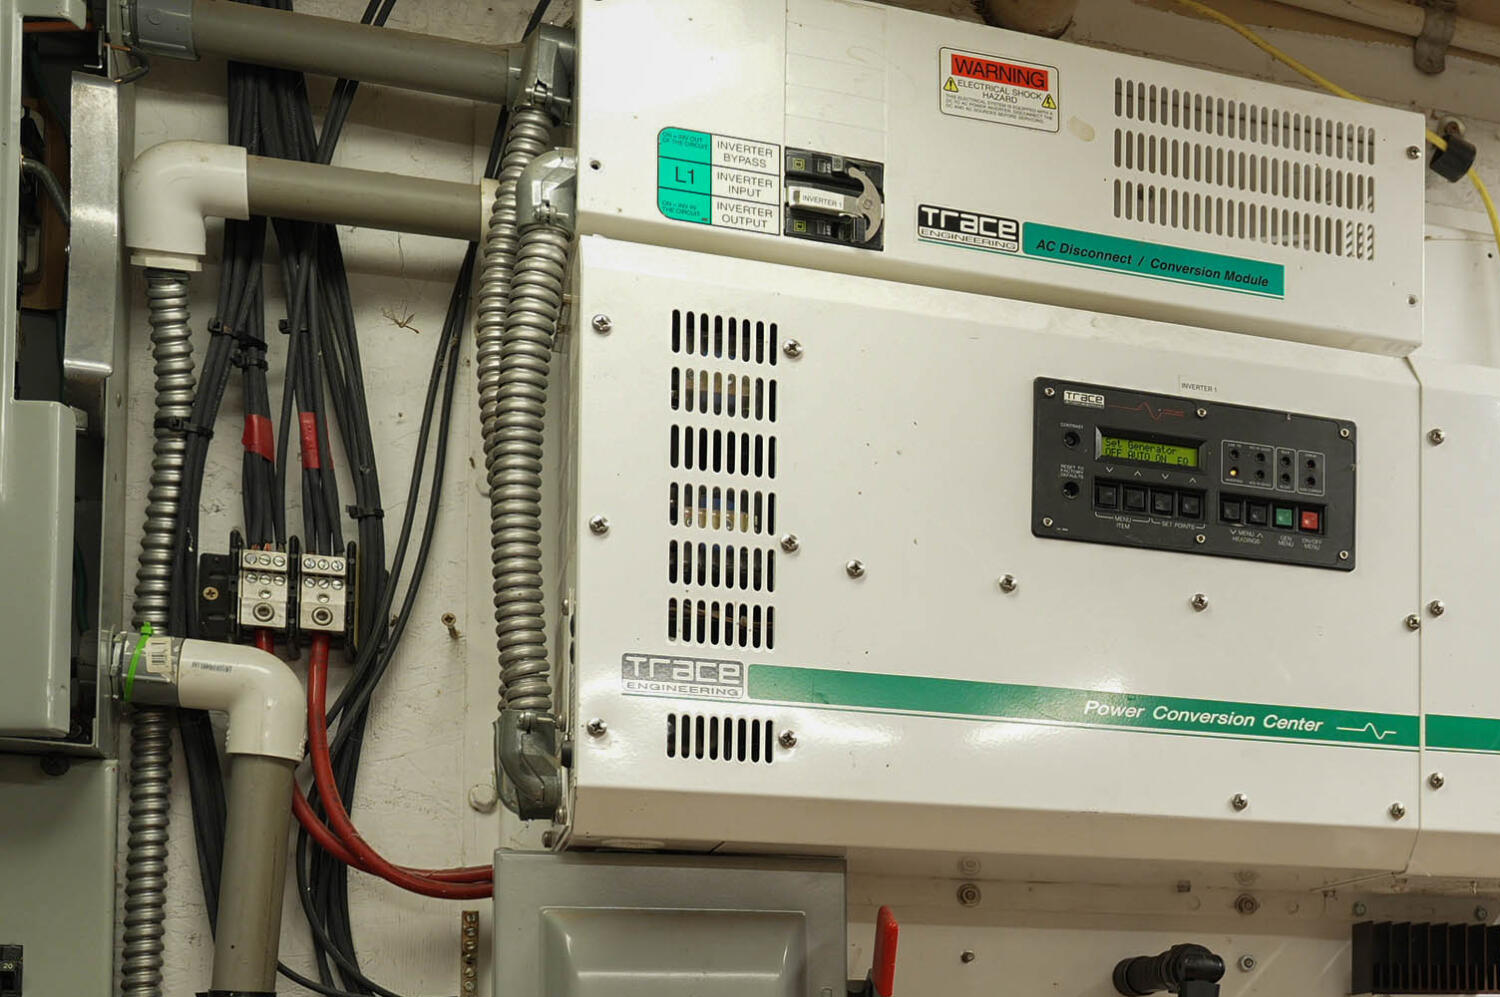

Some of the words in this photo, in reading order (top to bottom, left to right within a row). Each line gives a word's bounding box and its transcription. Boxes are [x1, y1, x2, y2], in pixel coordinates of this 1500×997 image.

[954, 57, 1045, 88] WARNING
[957, 80, 1010, 95] ELECTRICAL
[1012, 89, 1042, 100] SHOCK
[982, 92, 1018, 104] HAZARD
[717, 140, 773, 157] INVERTER
[723, 153, 767, 168] BYPASS
[675, 166, 694, 184] L1
[717, 171, 773, 188] INVERTER
[728, 185, 762, 198] INPUT
[802, 193, 837, 207] INVERTER
[716, 201, 773, 218] INVERTER
[721, 213, 768, 228] OUTPUT
[920, 228, 1017, 250] ENGINEERING
[1036, 239, 1056, 252] AC
[1060, 241, 1132, 266] Disconnect
[1150, 258, 1221, 280] Conversion
[1225, 270, 1269, 287] Module
[1181, 383, 1212, 392] INVERTER
[1106, 439, 1120, 448] Set
[1128, 441, 1177, 455] Generator
[1105, 448, 1121, 456] OFF
[1128, 452, 1150, 460] AUTO
[1155, 455, 1167, 463] ON
[627, 682, 738, 696] ENGINEERING
[1083, 700, 1145, 718] Power
[1153, 705, 1255, 727] Conversion
[1263, 714, 1323, 733] Center
